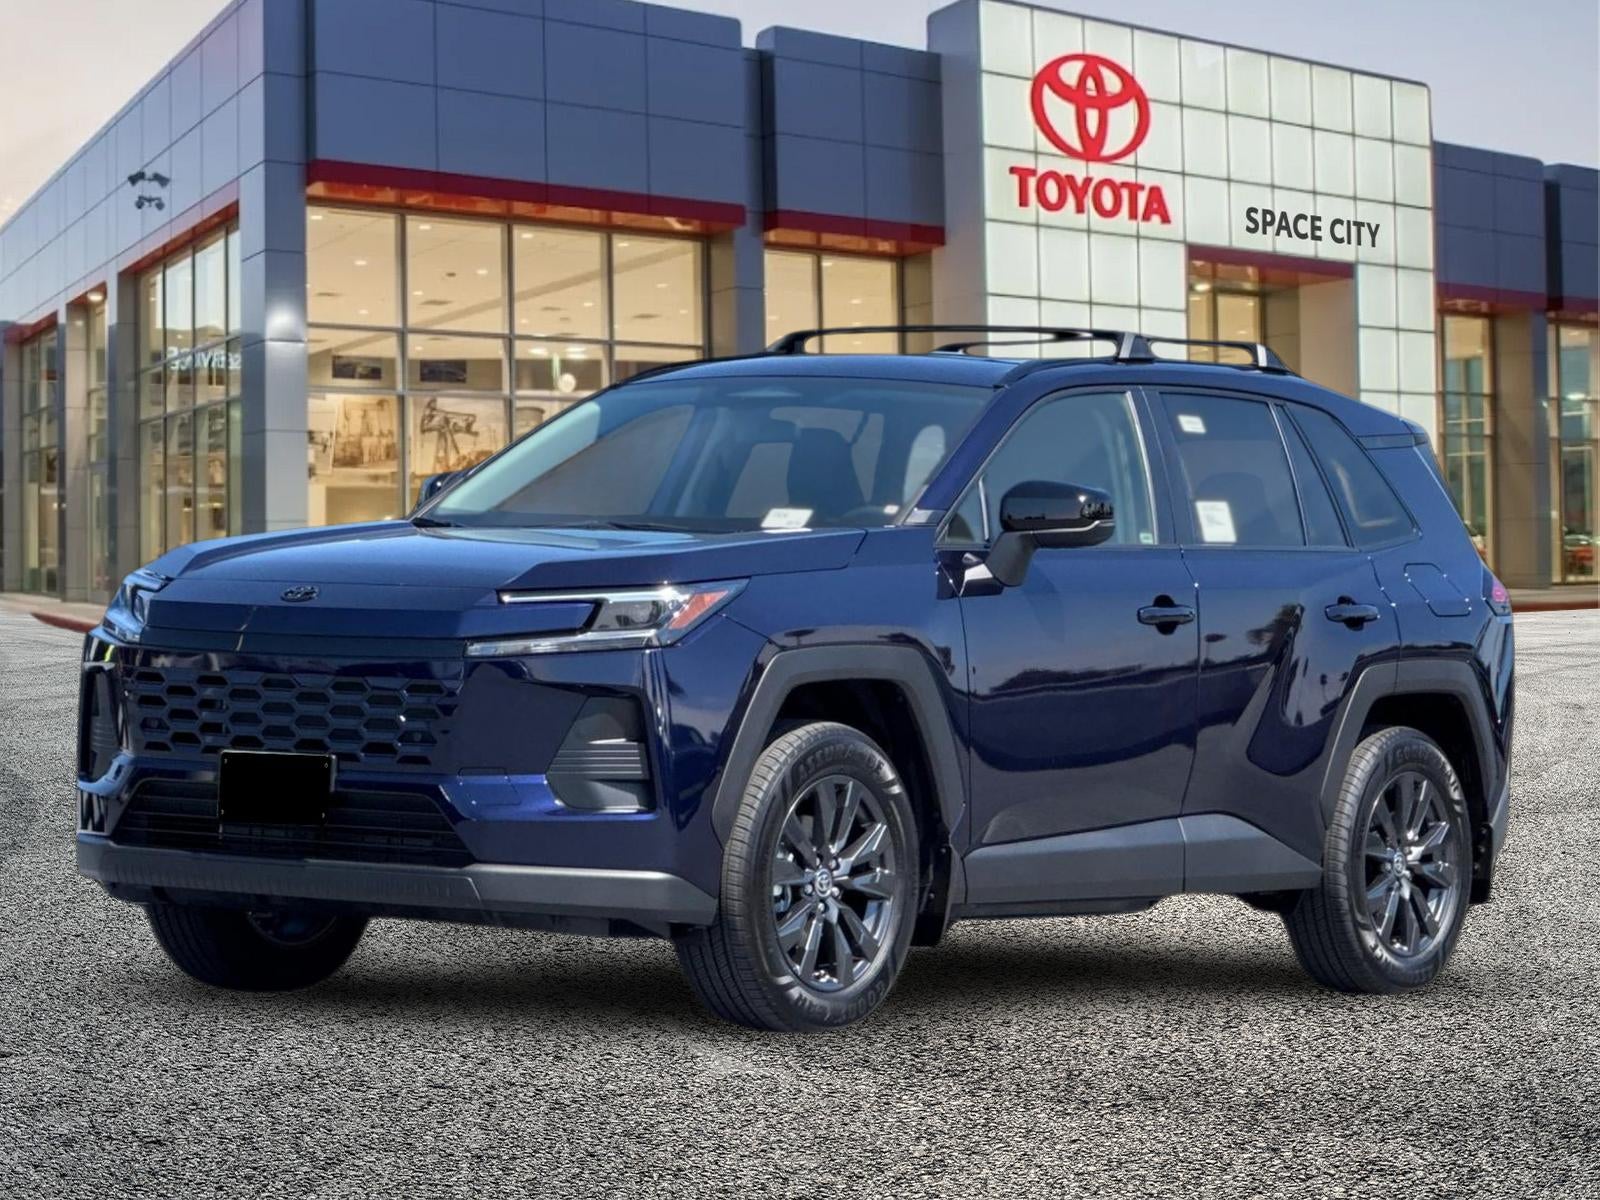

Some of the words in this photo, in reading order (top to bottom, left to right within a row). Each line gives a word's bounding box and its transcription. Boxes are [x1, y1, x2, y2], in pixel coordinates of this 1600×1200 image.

[1009, 166, 1171, 224] TOYOTA
[1245, 206, 1323, 242] SPACE
[1329, 218, 1381, 248] CITY
